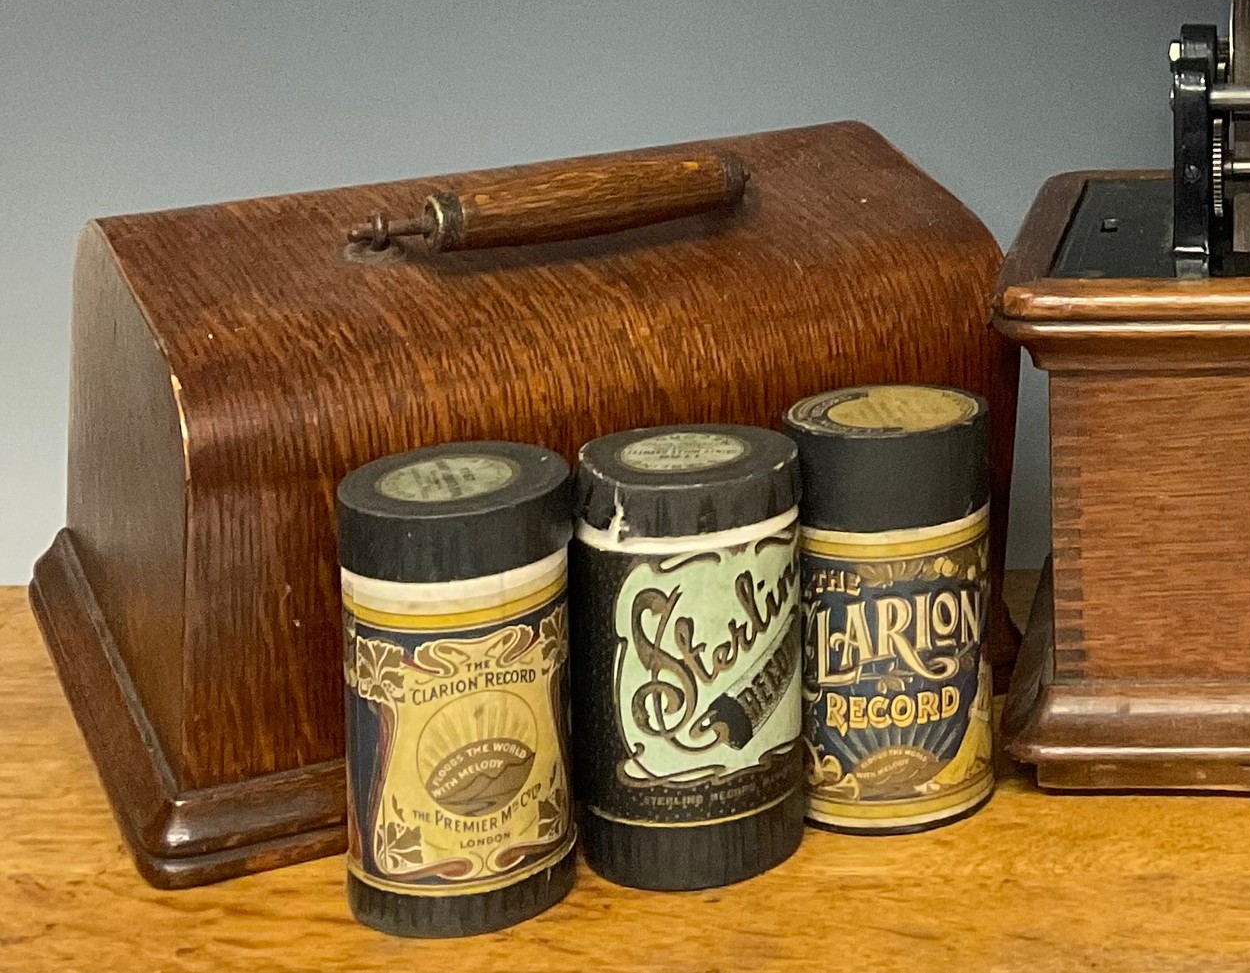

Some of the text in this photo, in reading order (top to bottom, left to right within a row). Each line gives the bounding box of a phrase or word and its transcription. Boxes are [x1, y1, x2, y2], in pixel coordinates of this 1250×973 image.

[812, 568, 862, 597] THE
[465, 659, 492, 673] THE
[484, 668, 537, 689] RECORD
[825, 685, 961, 737] RECORD
[431, 742, 528, 788] FLOODS THE WORLD
[430, 759, 505, 799] WITH MELODY
[412, 808, 431, 824] THE
[434, 809, 498, 834] PREMIER
[459, 830, 511, 850] LONDON
